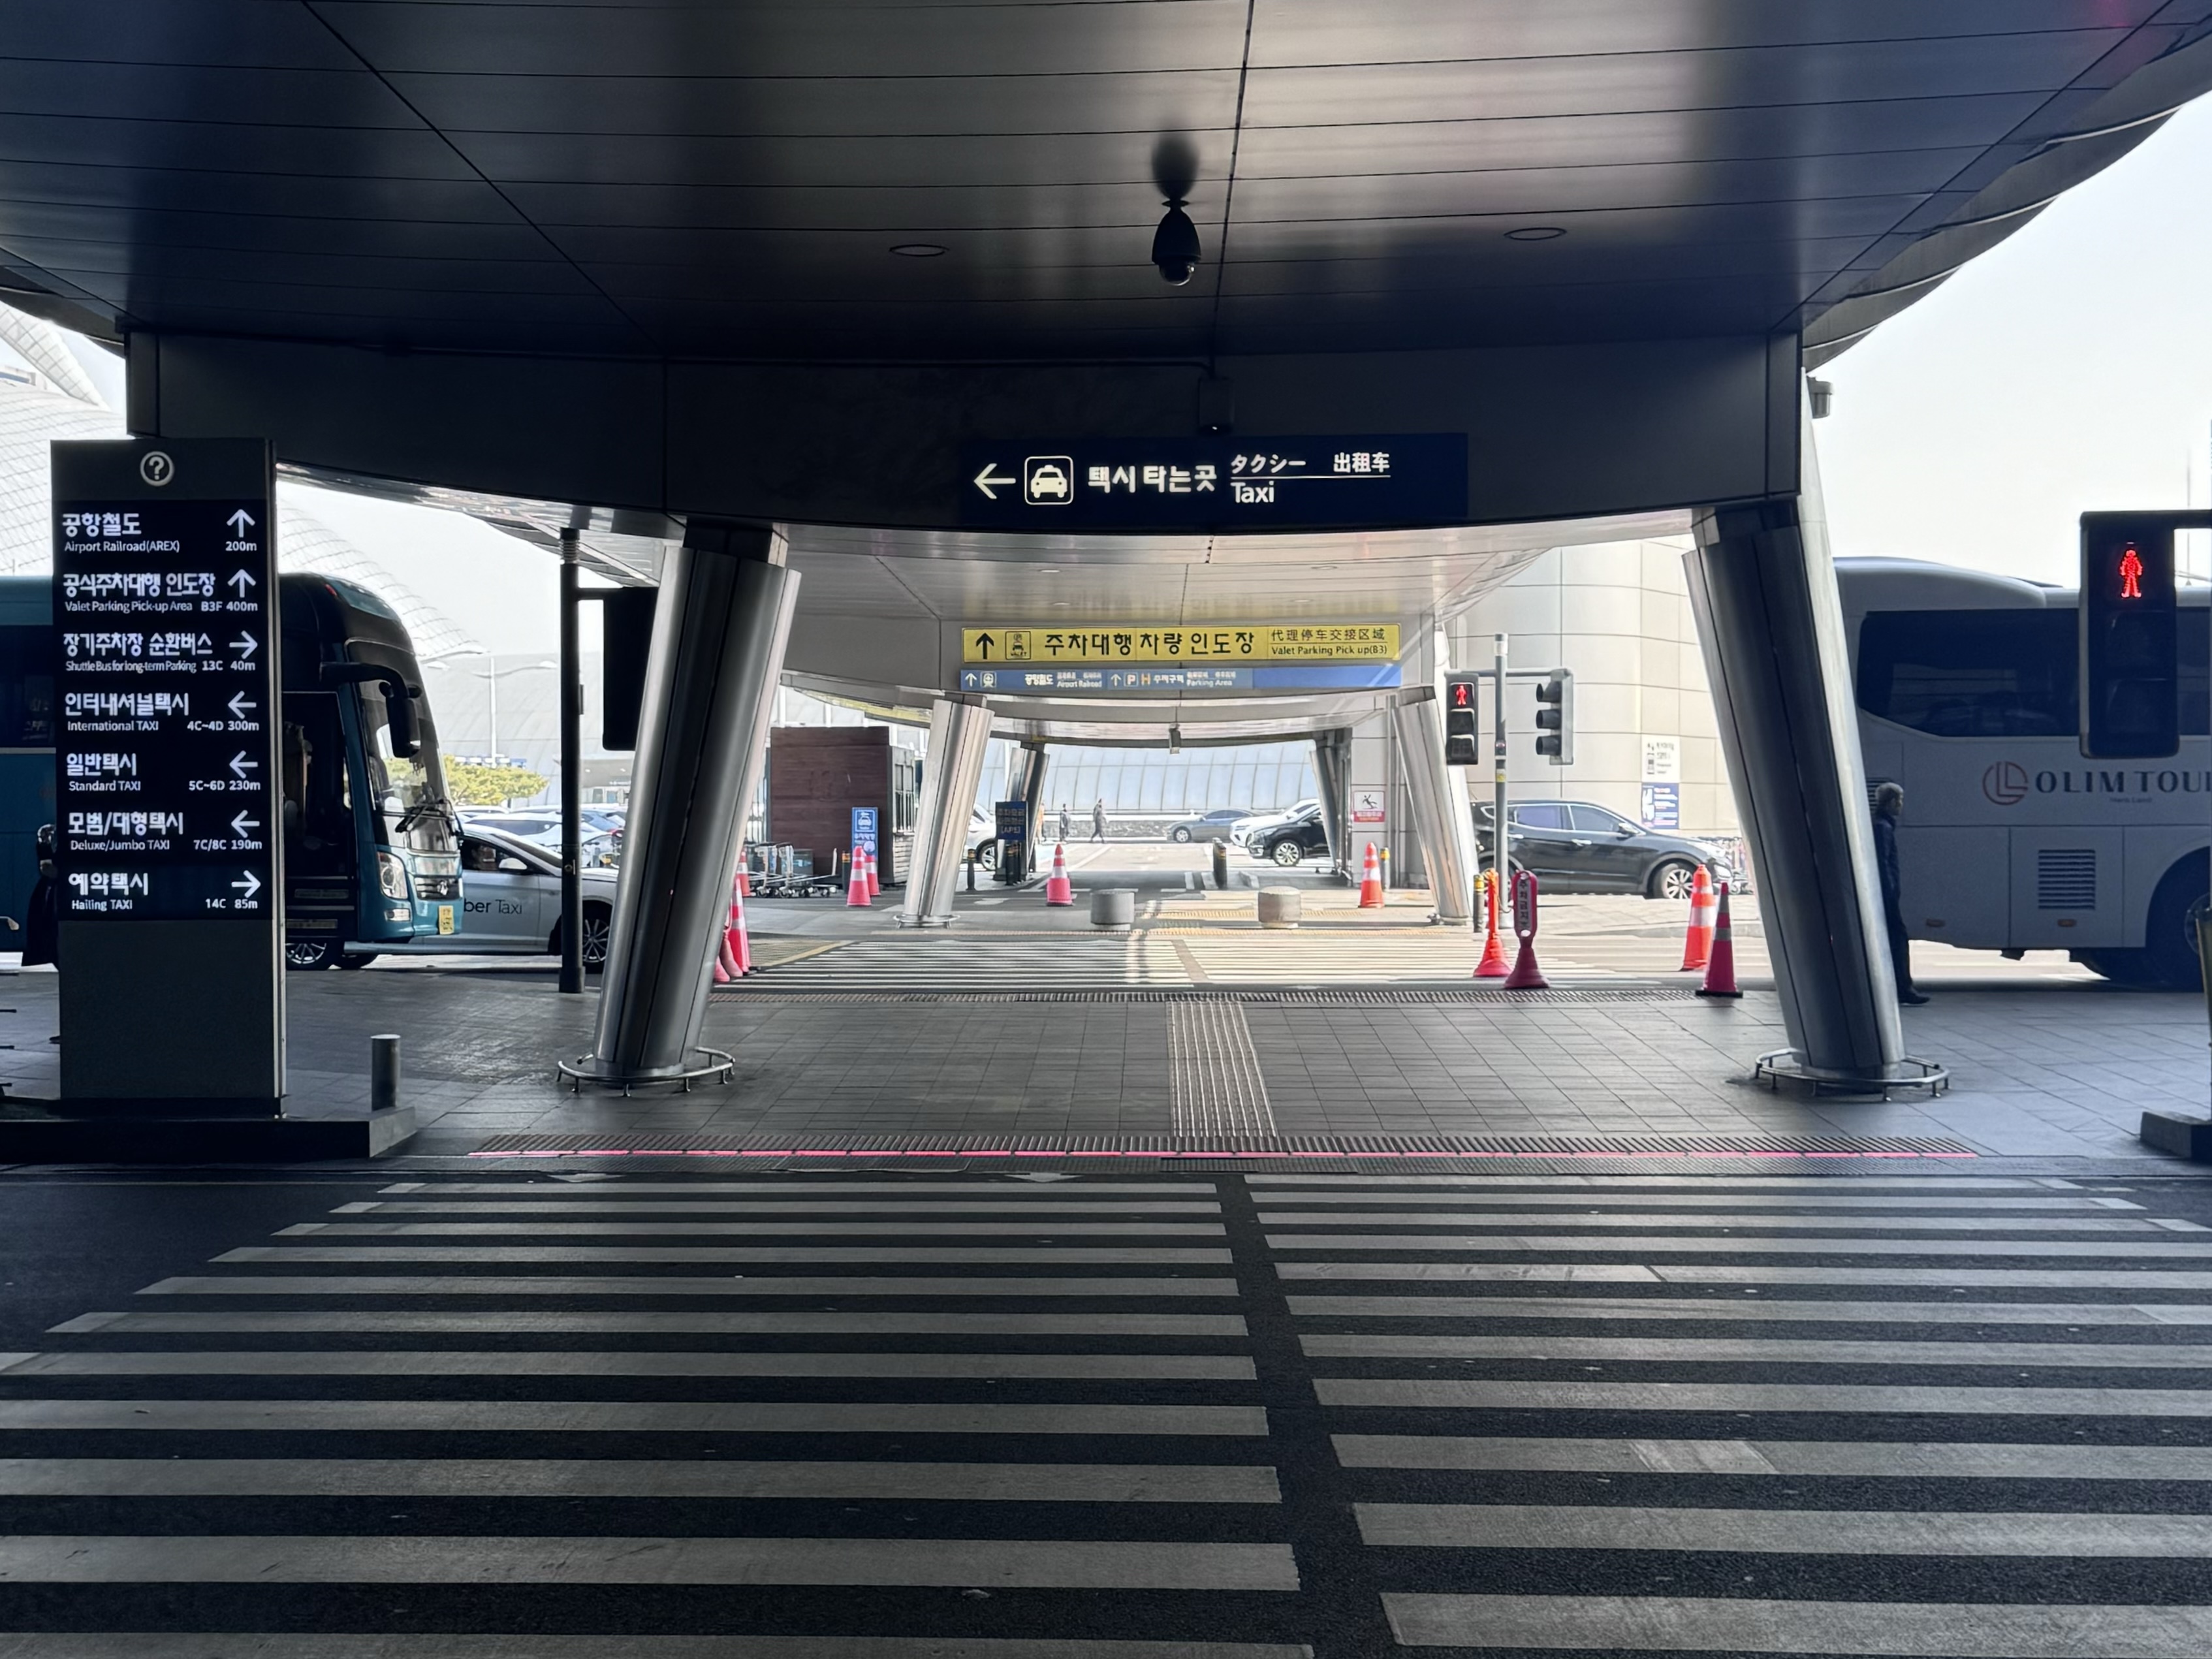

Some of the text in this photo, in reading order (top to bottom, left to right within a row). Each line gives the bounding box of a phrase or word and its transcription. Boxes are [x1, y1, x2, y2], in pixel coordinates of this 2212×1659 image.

[1231, 454, 1306, 473] タクシー
[1334, 452, 1389, 473] 出租车
[1088, 466, 1216, 493] 택시 타는곳
[1231, 481, 1274, 503] Taxi
[63, 513, 141, 537] 공항철도
[65, 541, 180, 553] Airport Railroad(AREX)
[226, 541, 257, 551] 200m
[63, 573, 215, 597] 공식주차대행 인도장
[65, 601, 192, 614] Valet Parking Pick-up Area
[201, 601, 257, 611] B3F 400m
[1271, 628, 1384, 641] 代理停车交接区域
[64, 633, 212, 657] 장기주차장 순환버스
[1045, 633, 1254, 656] 주차대행 차량 인도장
[1272, 645, 1295, 655] Valet
[1298, 646, 1333, 656] Parking
[66, 660, 197, 673] Shuttle Bus for long-term Parking
[202, 661, 255, 671] 13C 40m
[65, 693, 189, 716] 인터내셔널택시
[68, 721, 158, 731] International TAXI
[187, 721, 259, 731] 4C~4D 300m
[67, 753, 136, 776] 일반택시
[69, 780, 140, 791] Standard TAXI
[189, 780, 261, 791] 5C~6D 230m
[2036, 771, 2124, 793] OLIM
[69, 812, 183, 836] 모범/대형택시
[71, 840, 169, 851] Deluxe/Jumbo TAXI
[194, 839, 262, 851] 7C/8C 190m
[69, 873, 148, 895] 예약택시
[72, 900, 132, 911] Hailing TAXI
[206, 898, 257, 908] 14C 85m
[464, 897, 522, 915] ber Taxi
